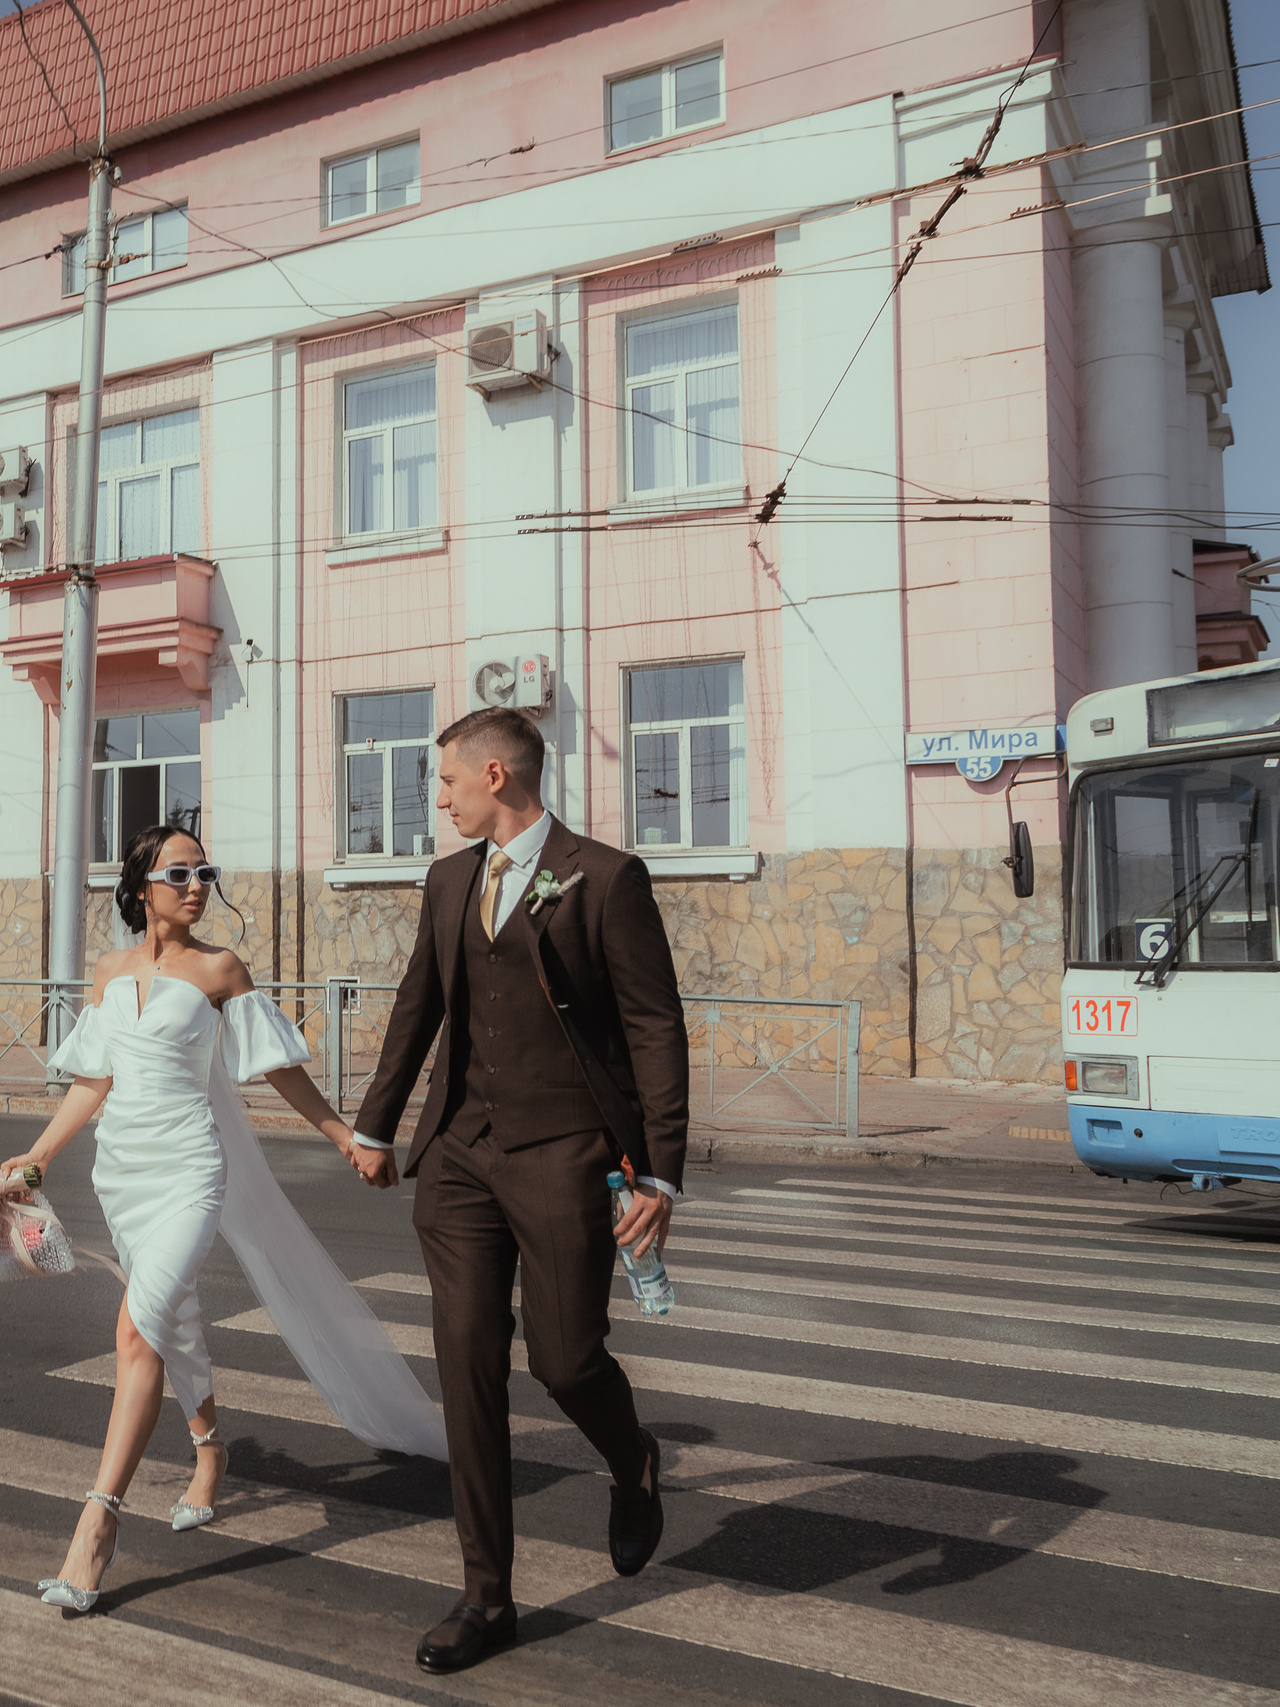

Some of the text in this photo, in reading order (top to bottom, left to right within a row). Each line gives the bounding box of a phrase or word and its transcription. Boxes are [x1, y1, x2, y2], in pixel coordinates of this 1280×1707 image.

[523, 675, 535, 683] LG
[923, 730, 1038, 757] ул. Мира
[966, 758, 992, 778] 55
[1140, 923, 1169, 960] 6
[1072, 1000, 1131, 1032] 1317
[1230, 1126, 1280, 1142] TRO
